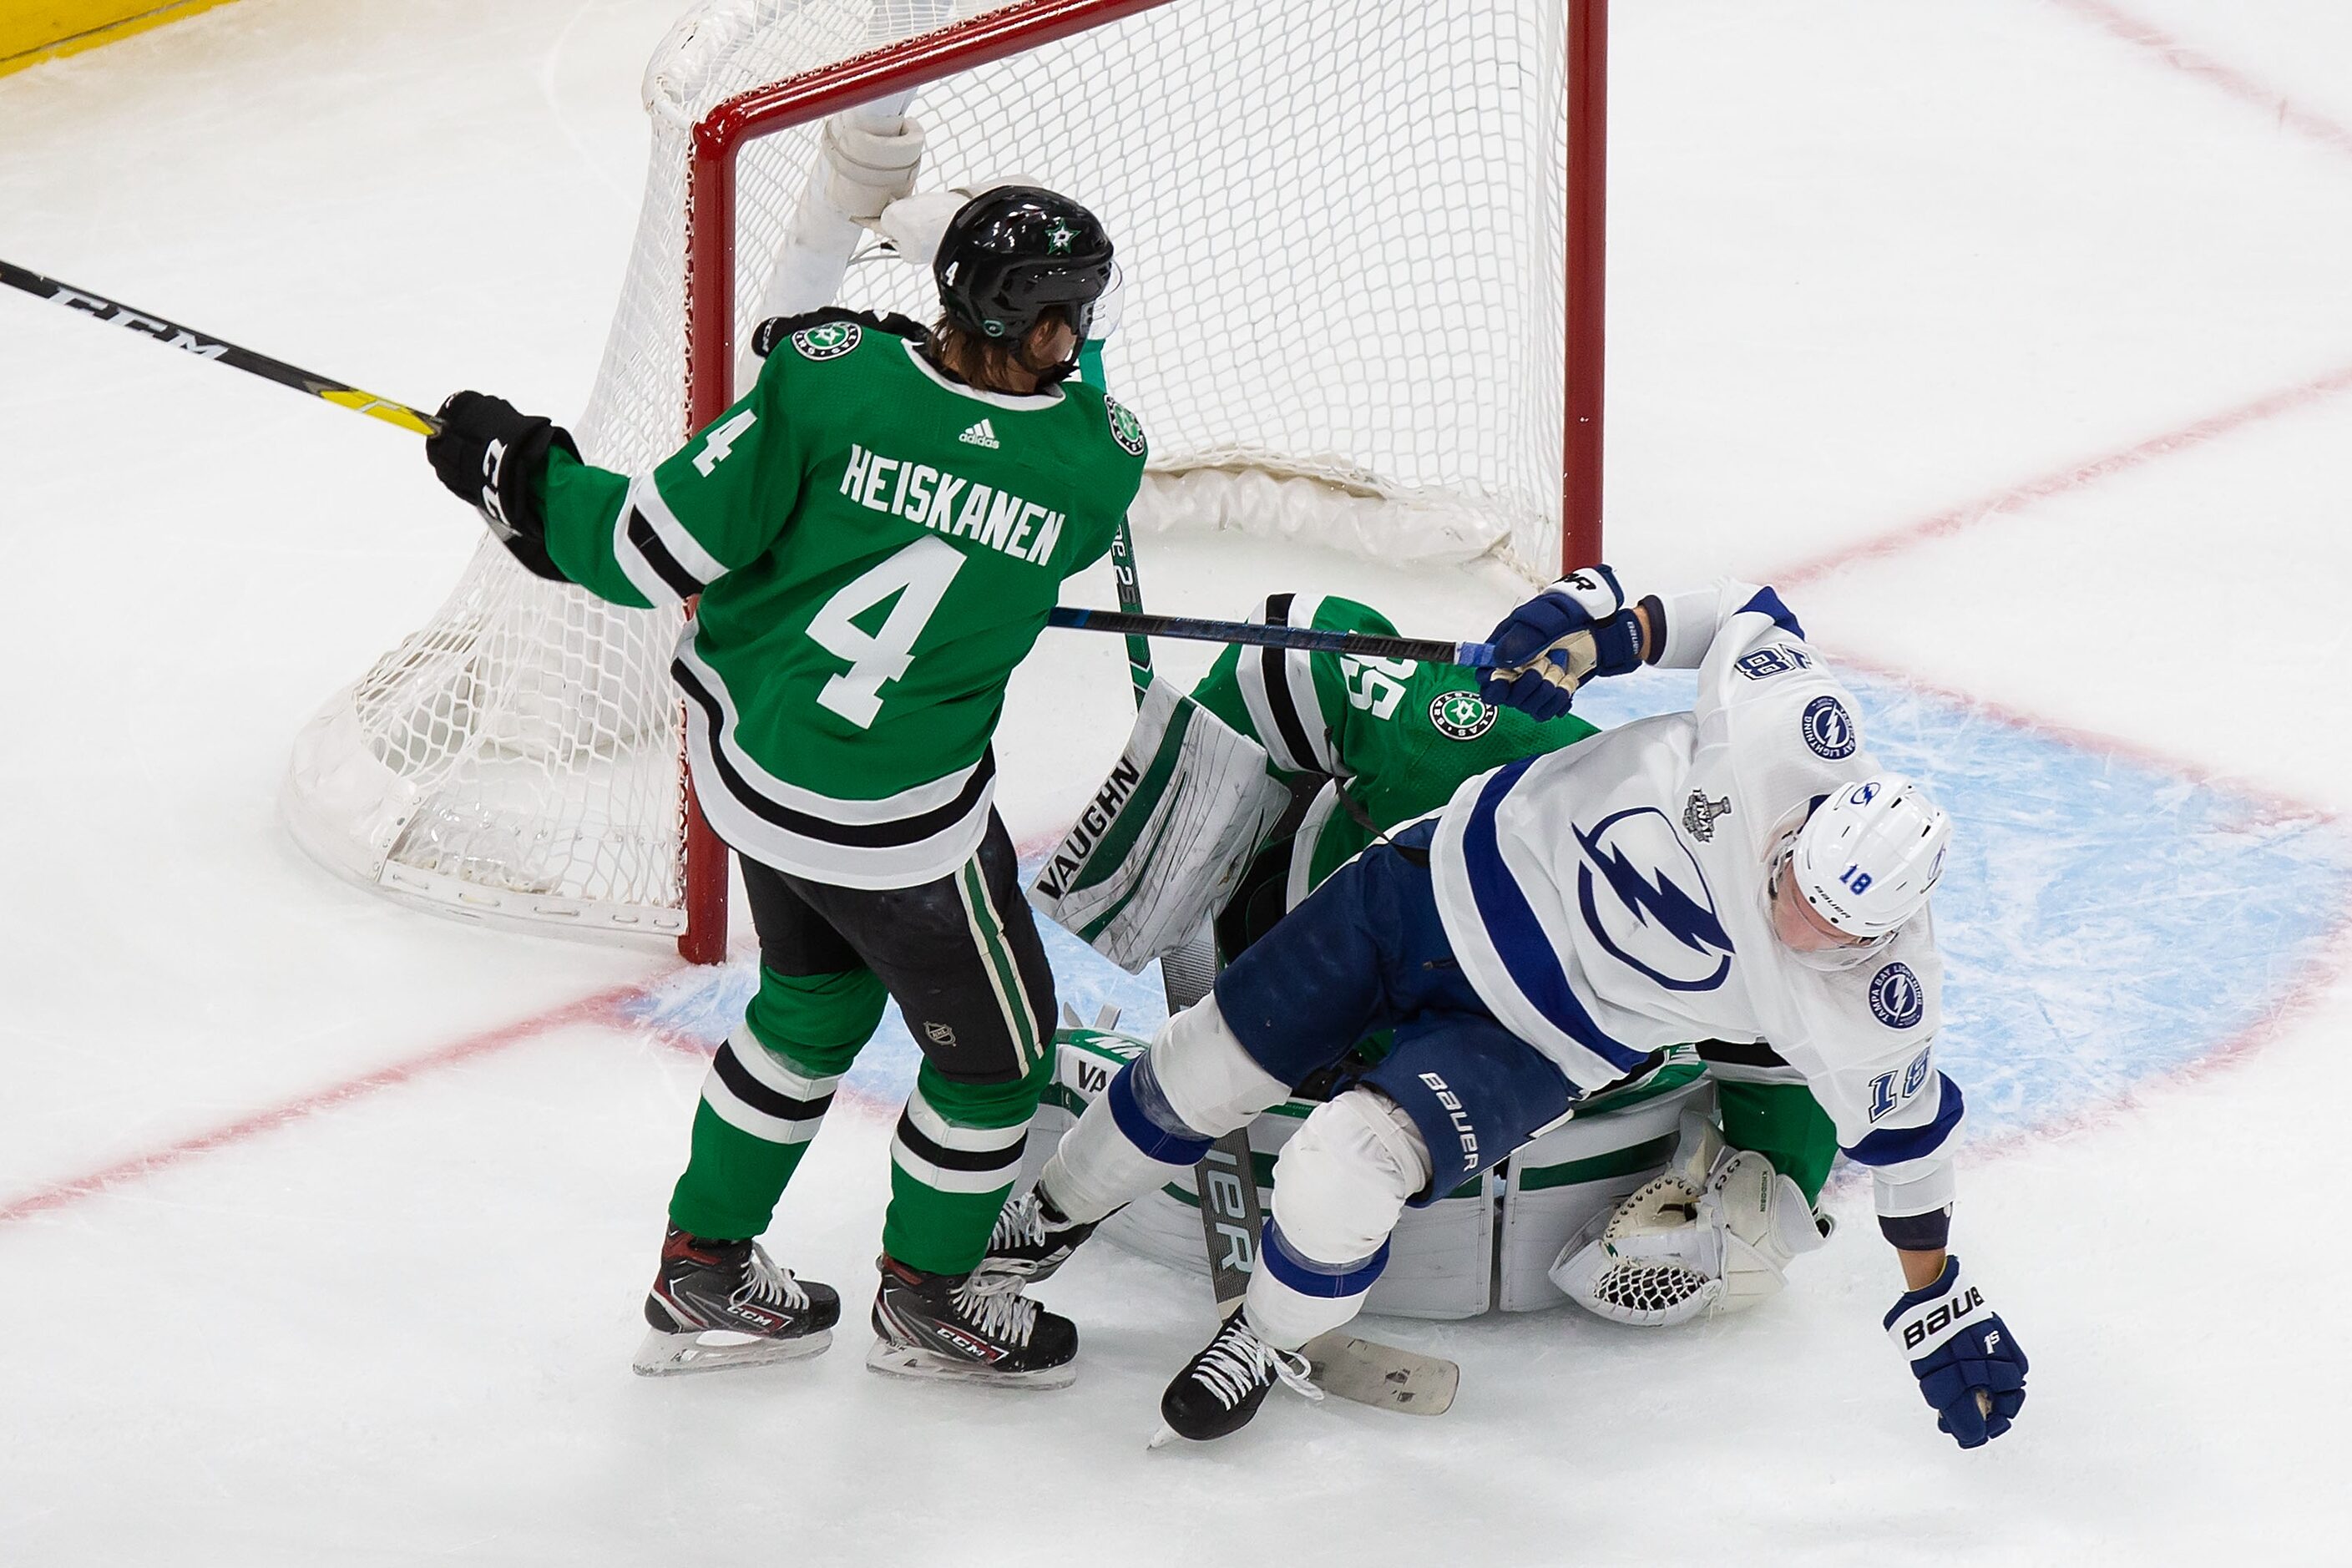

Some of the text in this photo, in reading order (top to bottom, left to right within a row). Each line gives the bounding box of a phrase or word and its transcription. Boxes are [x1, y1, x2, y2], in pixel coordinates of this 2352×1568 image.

[945, 261, 959, 287] 4
[48, 286, 230, 360] CCM
[691, 408, 758, 478] 4
[959, 433, 999, 449] adidas
[839, 443, 1065, 567] HEISKANEN
[805, 533, 968, 730] 4
[1036, 756, 1140, 900] VAUGHN
[1839, 862, 1873, 895] 18
[1874, 968, 1891, 986] BAY
[1870, 989, 1890, 1022] TAMPA
[1078, 1060, 1107, 1093] VA
[1868, 1044, 1931, 1124] 18
[726, 1305, 773, 1326] CCM
[936, 1327, 987, 1358] CCM
